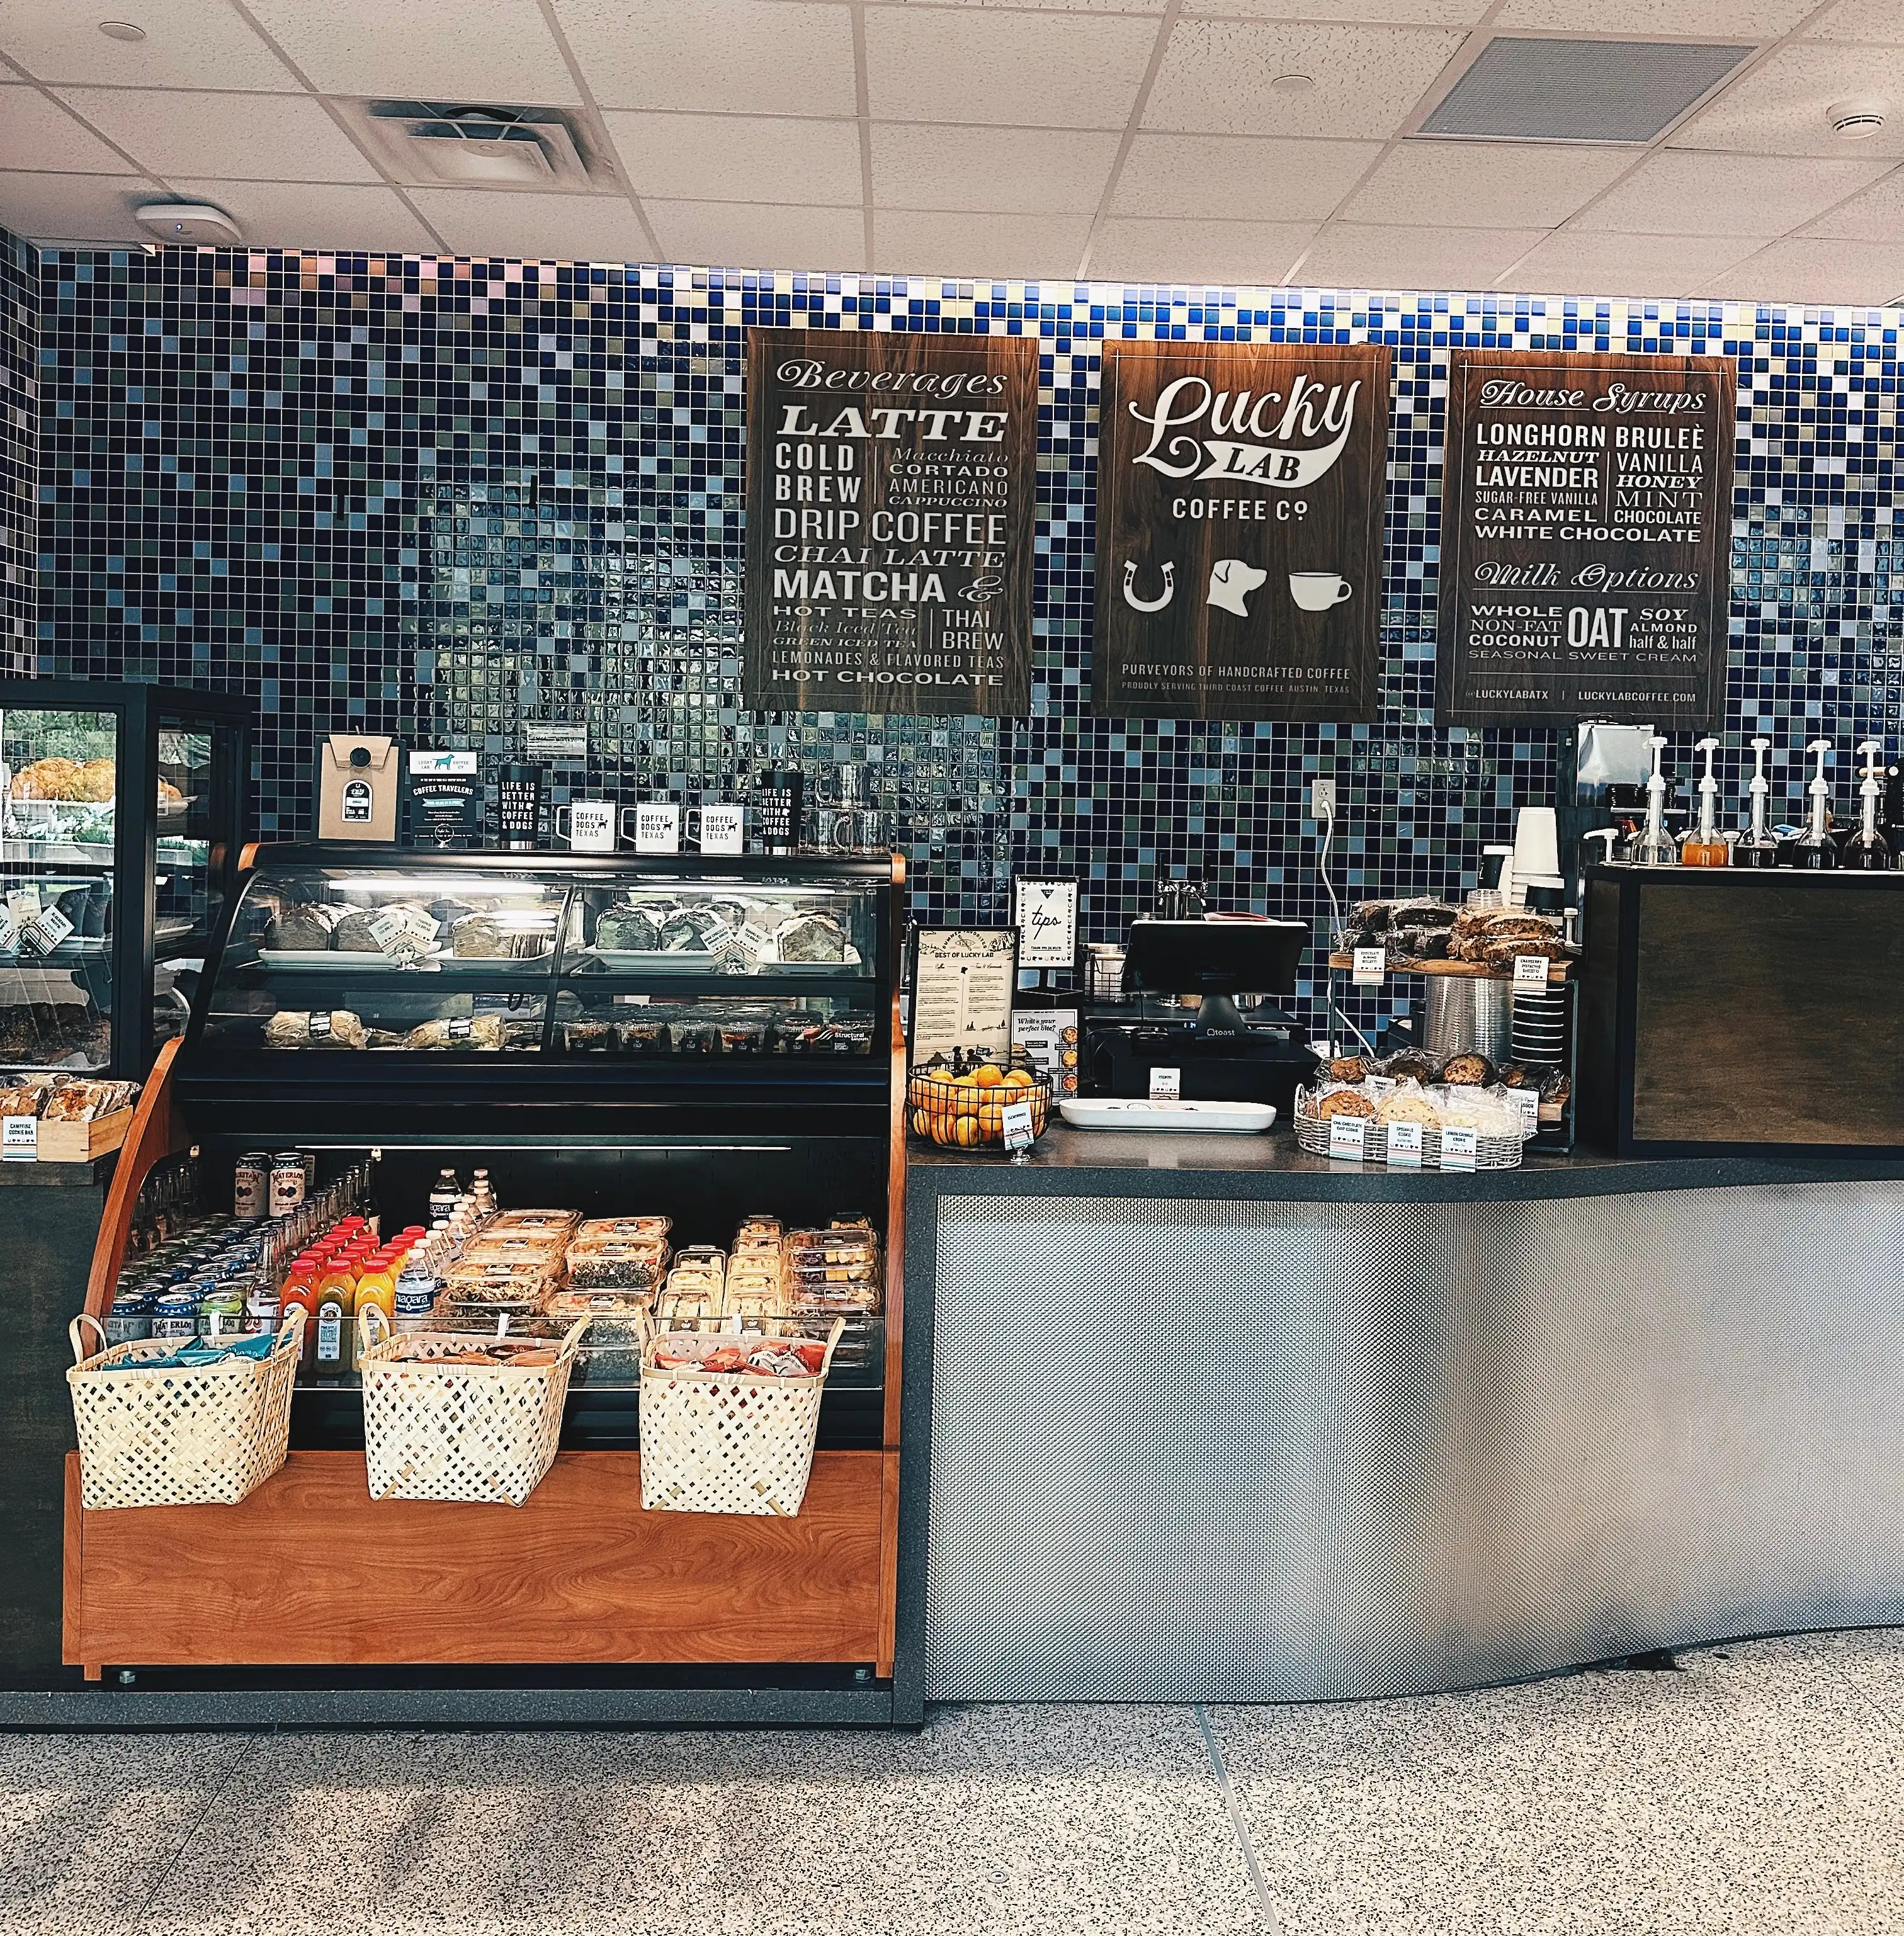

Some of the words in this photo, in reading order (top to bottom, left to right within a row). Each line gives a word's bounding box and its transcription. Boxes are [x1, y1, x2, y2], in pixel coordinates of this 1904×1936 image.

[776, 358, 1008, 399] Beverages
[1480, 379, 1585, 405] House
[1592, 383, 1706, 414] Syrups
[776, 405, 1009, 441] LATTE
[1129, 374, 1361, 478] Lucky
[1476, 424, 1606, 447] LONGHORN
[776, 442, 854, 471] COLD
[892, 448, 1008, 463] Macchiato
[1477, 450, 1599, 463] HAZELNUT
[1616, 453, 1703, 473] VANILLA
[889, 464, 1008, 477] CORTADO
[1223, 447, 1300, 482] LAB
[1476, 465, 1598, 489] LAVENDER
[1616, 475, 1703, 489] HONEY
[776, 475, 861, 503] BREW
[889, 478, 1008, 496] AMERICANO
[888, 495, 1007, 508] CAPPUCCINO
[1475, 490, 1546, 504] SUGAR-FREE
[1551, 492, 1597, 505] VANILLA
[1616, 490, 1703, 508] MINT
[1172, 499, 1266, 520] COFFEE
[1475, 508, 1597, 523] CARAMEL
[1614, 510, 1701, 524] CHOCOLATE
[774, 508, 859, 541] DRIP
[872, 511, 1006, 545] COFFEE
[1475, 525, 1553, 540] WHITE
[1560, 527, 1700, 543] CHOCOLATE
[774, 545, 871, 564] CHAI
[883, 548, 1006, 569] LATTE
[1475, 562, 1561, 586] Milk
[1570, 563, 1699, 593] Options
[774, 569, 945, 603] MATCHA
[958, 575, 1003, 603] &
[773, 606, 831, 617] HOT
[842, 608, 917, 619] TEAS
[942, 609, 990, 628] THAI
[1471, 605, 1562, 617] WHOLE
[1640, 608, 1689, 621] SOY
[775, 620, 829, 633] Black
[837, 621, 874, 635] Iced
[882, 623, 917, 635] Tea
[1470, 620, 1562, 633] NON-FAT
[1568, 607, 1628, 648] OAT
[1630, 623, 1697, 633] ALMOND
[773, 637, 833, 647] GREEN
[838, 638, 878, 648] ICED
[884, 640, 917, 648] TEA
[943, 631, 1004, 650] BREW
[1469, 634, 1561, 647] COCONUT
[1629, 635, 1653, 649] half
[1657, 636, 1669, 649] &
[1672, 636, 1696, 650] half
[773, 651, 862, 665] LEMONADES
[870, 654, 880, 665] &
[888, 654, 961, 668] FLAVORED
[969, 656, 1004, 669] TEAS
[1468, 650, 1562, 659] SEASONAL
[1568, 652, 1629, 661] SWEET
[1636, 654, 1696, 662] CREAM
[773, 670, 829, 682] HOT
[837, 671, 1003, 686] CHOCOLATE
[1122, 664, 1194, 677] PURVEYORS
[1199, 665, 1214, 677] OF
[1219, 666, 1302, 679] HANDCRAFTED
[1307, 667, 1351, 679] COFFEE
[1121, 681, 1158, 690] PROUDLY
[1161, 682, 1196, 691] SERVING
[1199, 683, 1223, 691] THIRD
[1226, 684, 1251, 692] COAST
[1466, 689, 1548, 699] @LUCKYLABATX
[1578, 692, 1696, 703] LUCKYLABCOFFEE.COM
[413, 785, 437, 795] COFFEE
[438, 785, 473, 795] TRAVELERS
[502, 781, 521, 791] LIFE
[526, 783, 535, 791] IS
[782, 788, 791, 796] IS
[502, 791, 535, 800] BETTER
[762, 798, 791, 807] BETTER
[502, 802, 524, 810] WITH
[762, 808, 780, 816] WITH
[502, 812, 533, 820] COFFEE
[576, 812, 604, 820] COFFEE
[762, 818, 790, 826] COFFEE
[502, 821, 507, 829] &
[509, 821, 533, 830] DOGS
[768, 827, 790, 835] DOGS
[1031, 904, 1062, 940] tips
[271, 1170, 303, 1185] WATERLOO
[395, 1293, 428, 1308] niagara
[153, 1318, 191, 1336] WATERLOO
